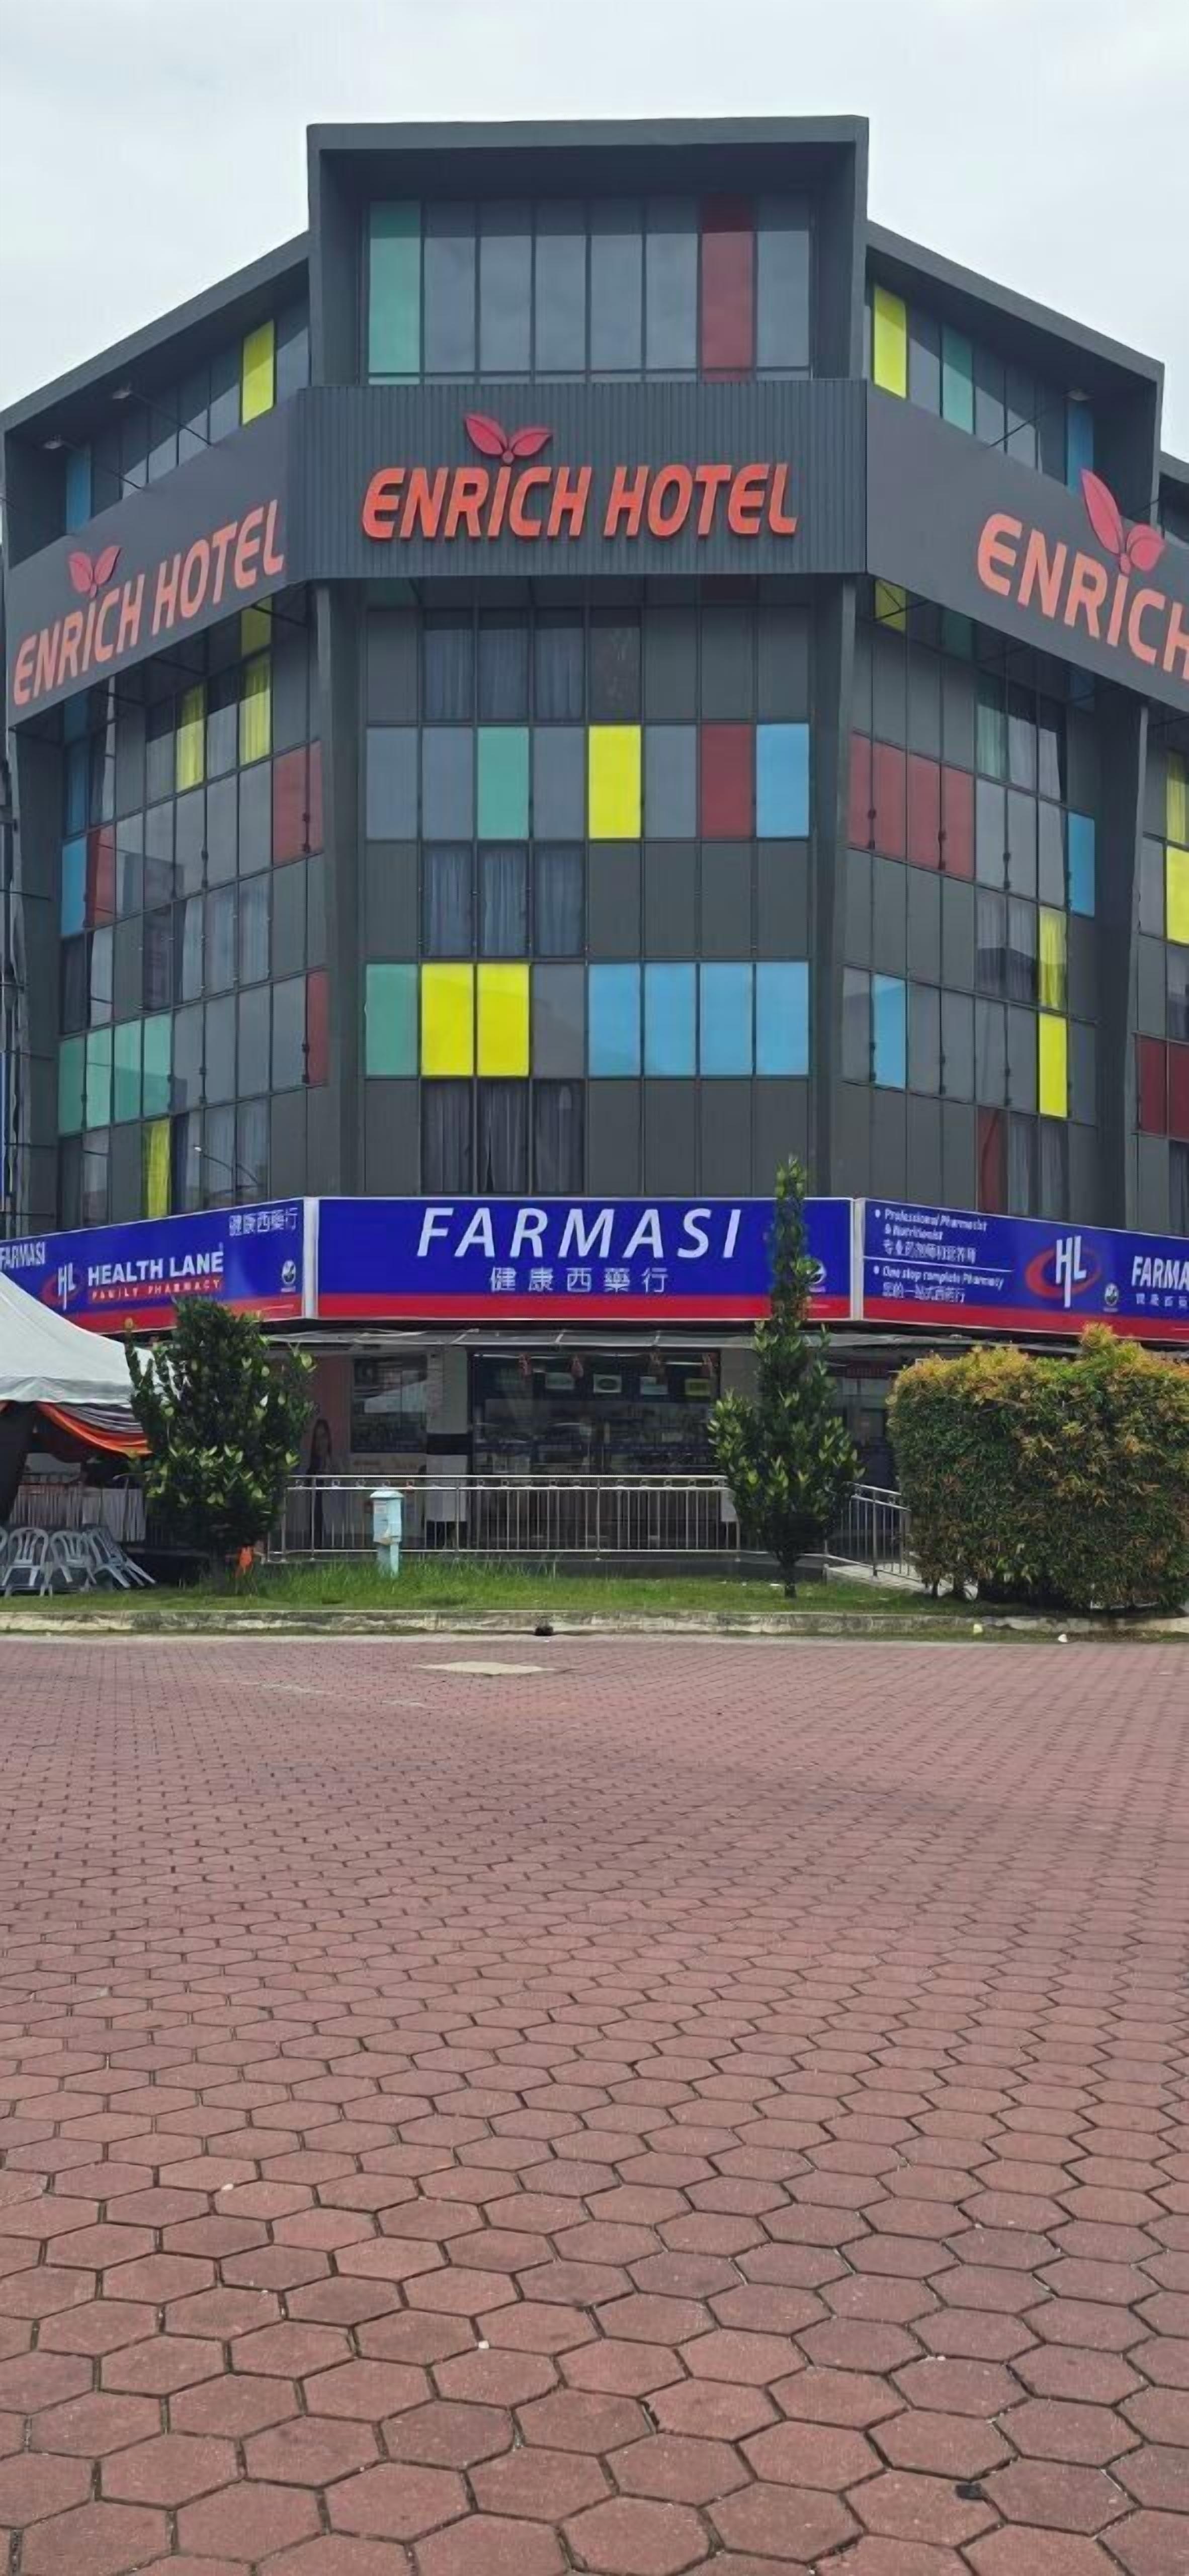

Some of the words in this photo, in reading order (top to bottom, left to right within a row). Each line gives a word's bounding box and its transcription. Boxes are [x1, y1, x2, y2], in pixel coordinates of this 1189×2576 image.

[362, 465, 592, 538] ENRICH
[604, 463, 798, 536] HOTEL
[14, 574, 145, 705] ENRICH
[152, 499, 285, 636] HOTEL
[416, 1208, 741, 1258] FARMASI
[0, 1241, 45, 1270] FARMASI
[88, 1258, 163, 1286] HEALTH
[169, 1251, 224, 1277] LANE
[1056, 1236, 1087, 1308] HL
[92, 1286, 138, 1301] FAMILY
[147, 1279, 220, 1296] PHARMACY
[490, 1266, 669, 1294] 健康西藥行
